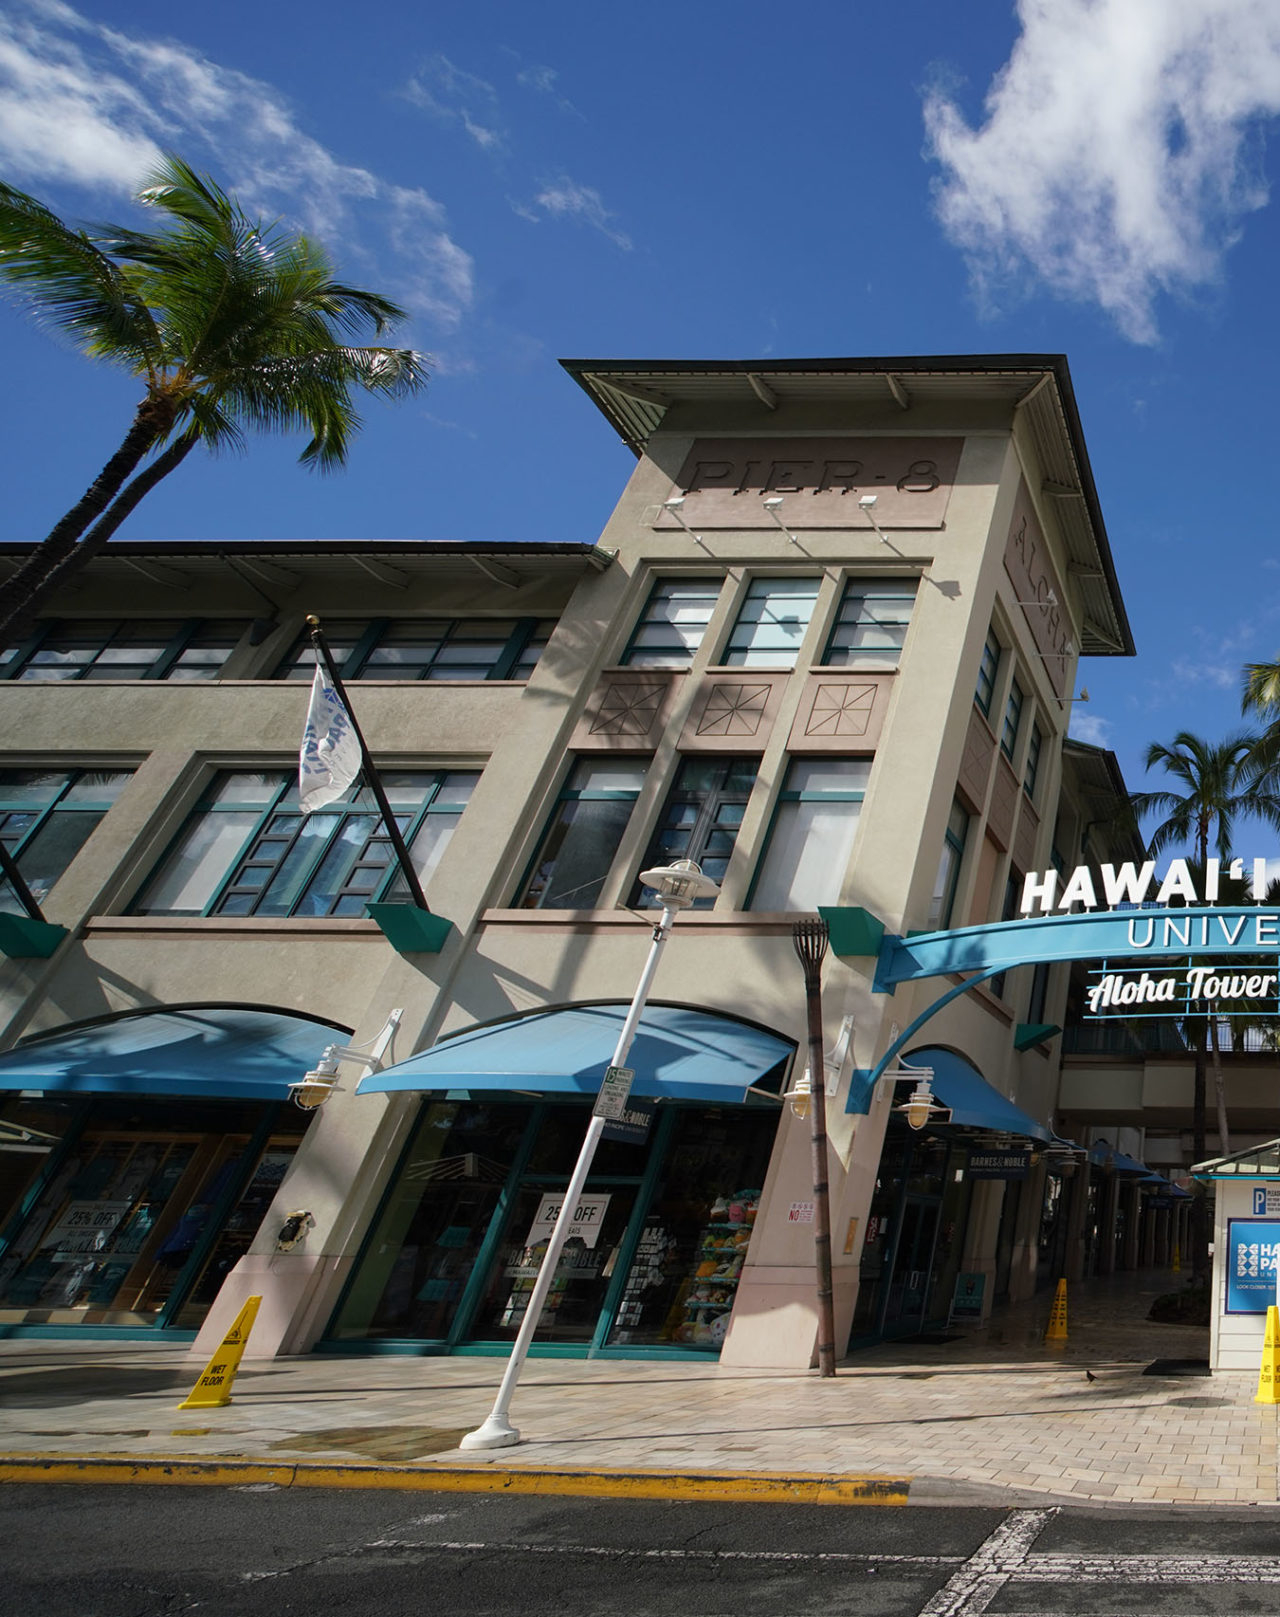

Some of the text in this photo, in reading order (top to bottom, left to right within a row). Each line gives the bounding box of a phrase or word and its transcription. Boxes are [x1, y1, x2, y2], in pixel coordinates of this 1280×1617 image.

[1088, 972, 1176, 1013] Aloha
[1186, 966, 1277, 1000] Tower
[606, 1069, 617, 1082] 15
[574, 1206, 597, 1221] OFF
[789, 1209, 800, 1221] NO
[211, 1364, 227, 1374] WET
[201, 1377, 224, 1386] FLOOR
